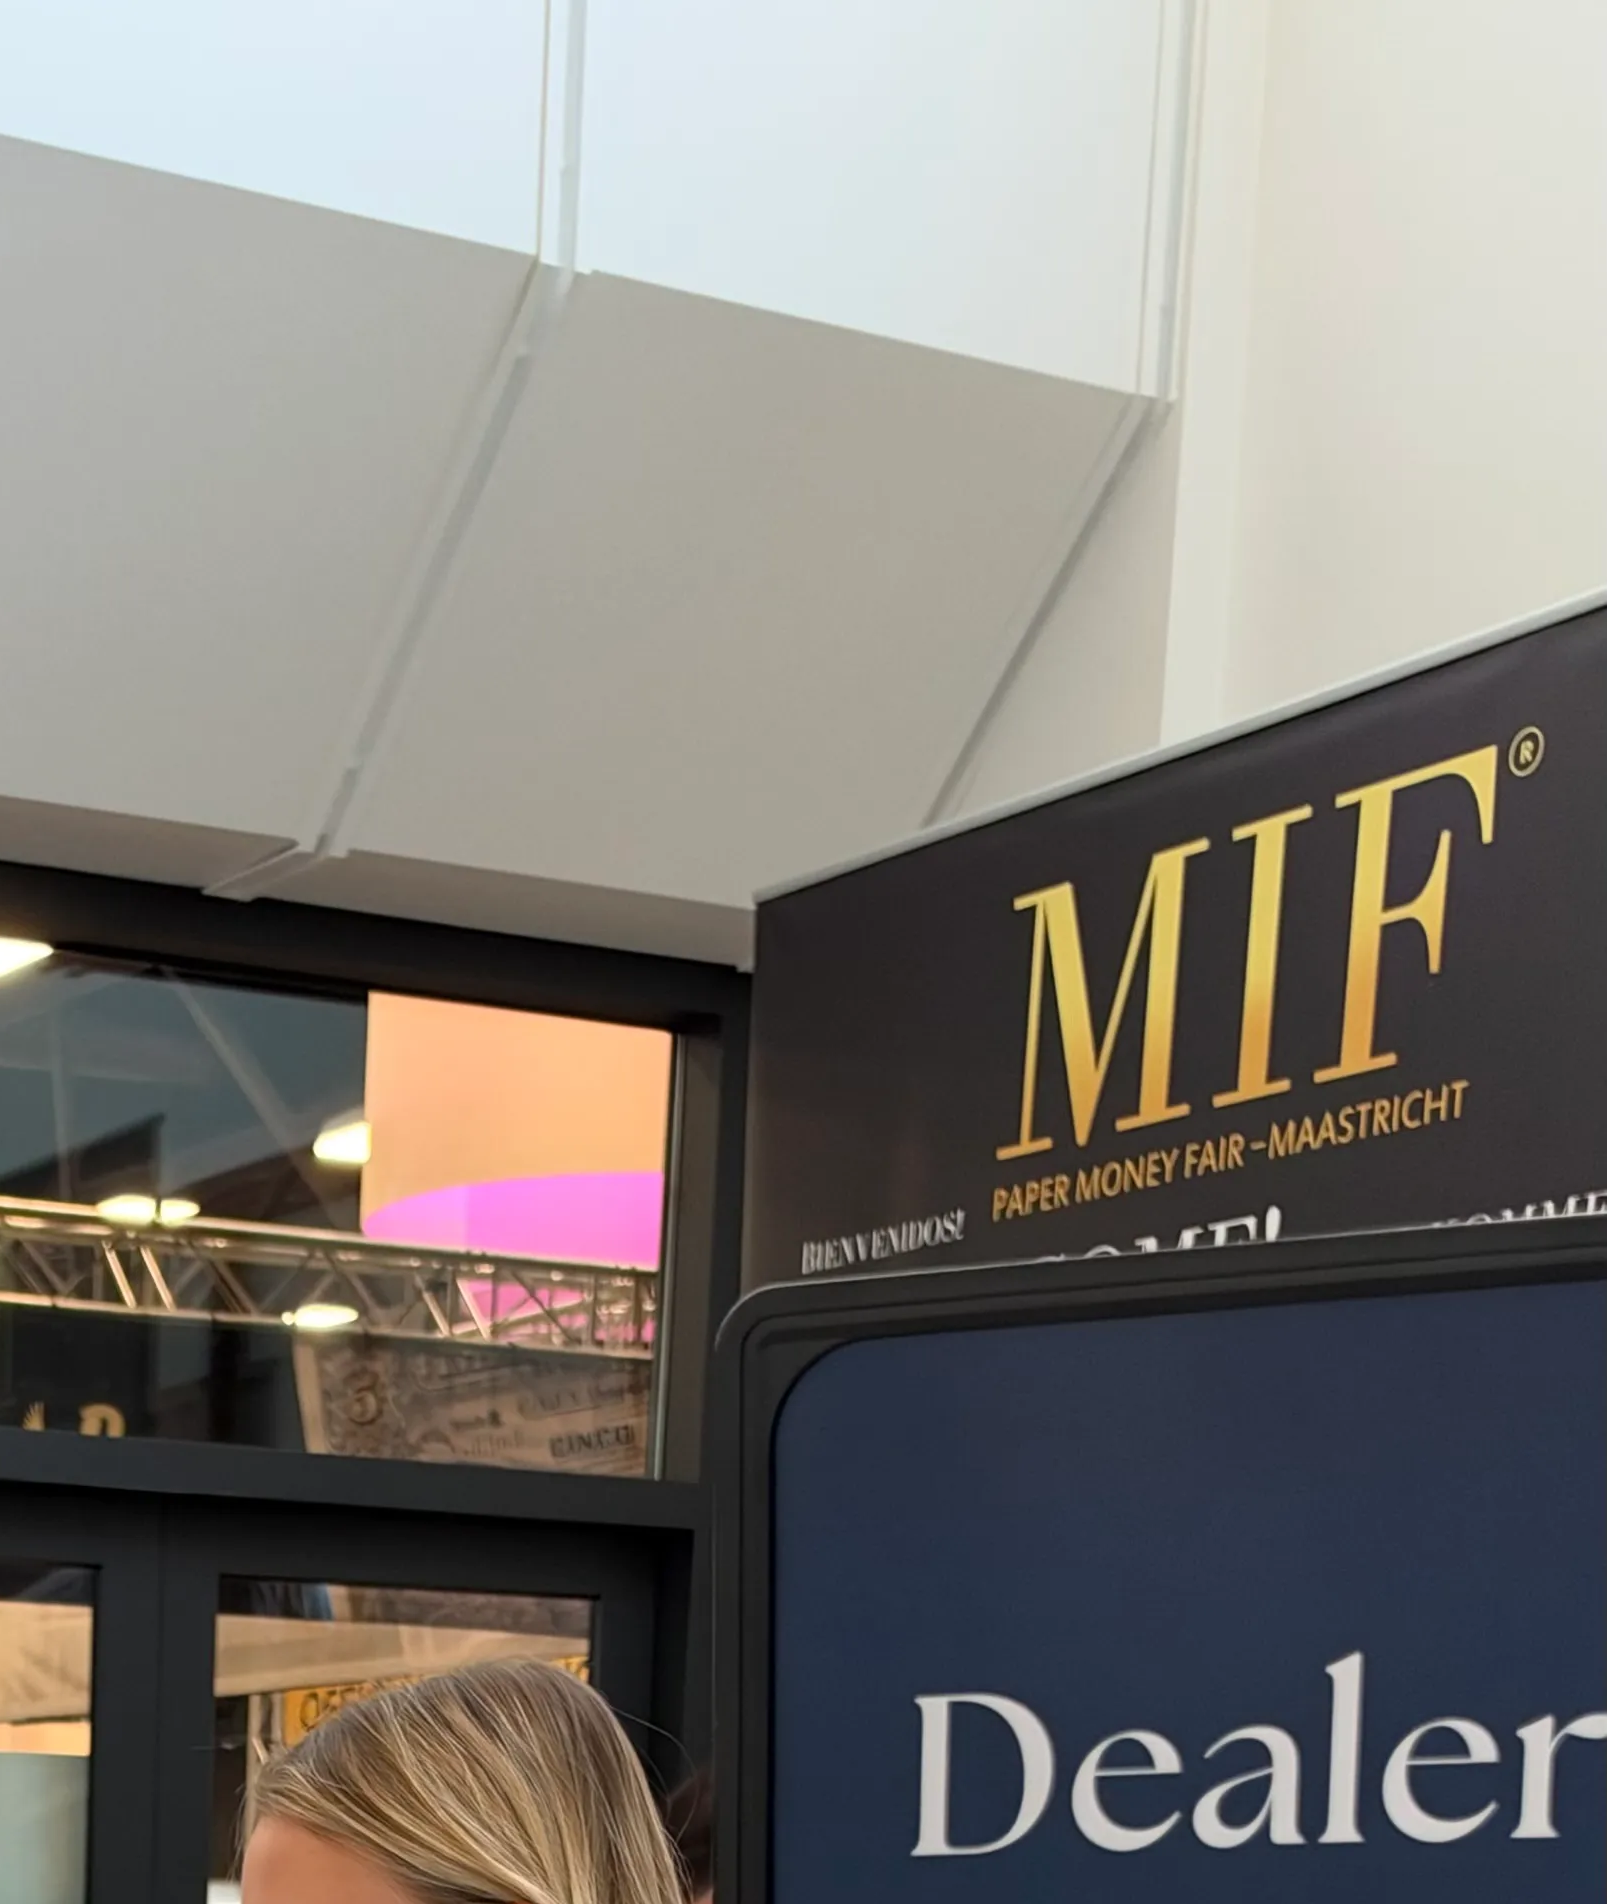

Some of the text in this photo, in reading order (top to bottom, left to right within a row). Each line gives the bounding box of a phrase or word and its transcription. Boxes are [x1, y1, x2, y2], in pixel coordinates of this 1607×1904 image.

[992, 1173, 1070, 1222] PAPER
[1074, 1147, 1178, 1206] MONEY
[1183, 1132, 1246, 1177] FAIR
[910, 1650, 1607, 1857] Dealer
